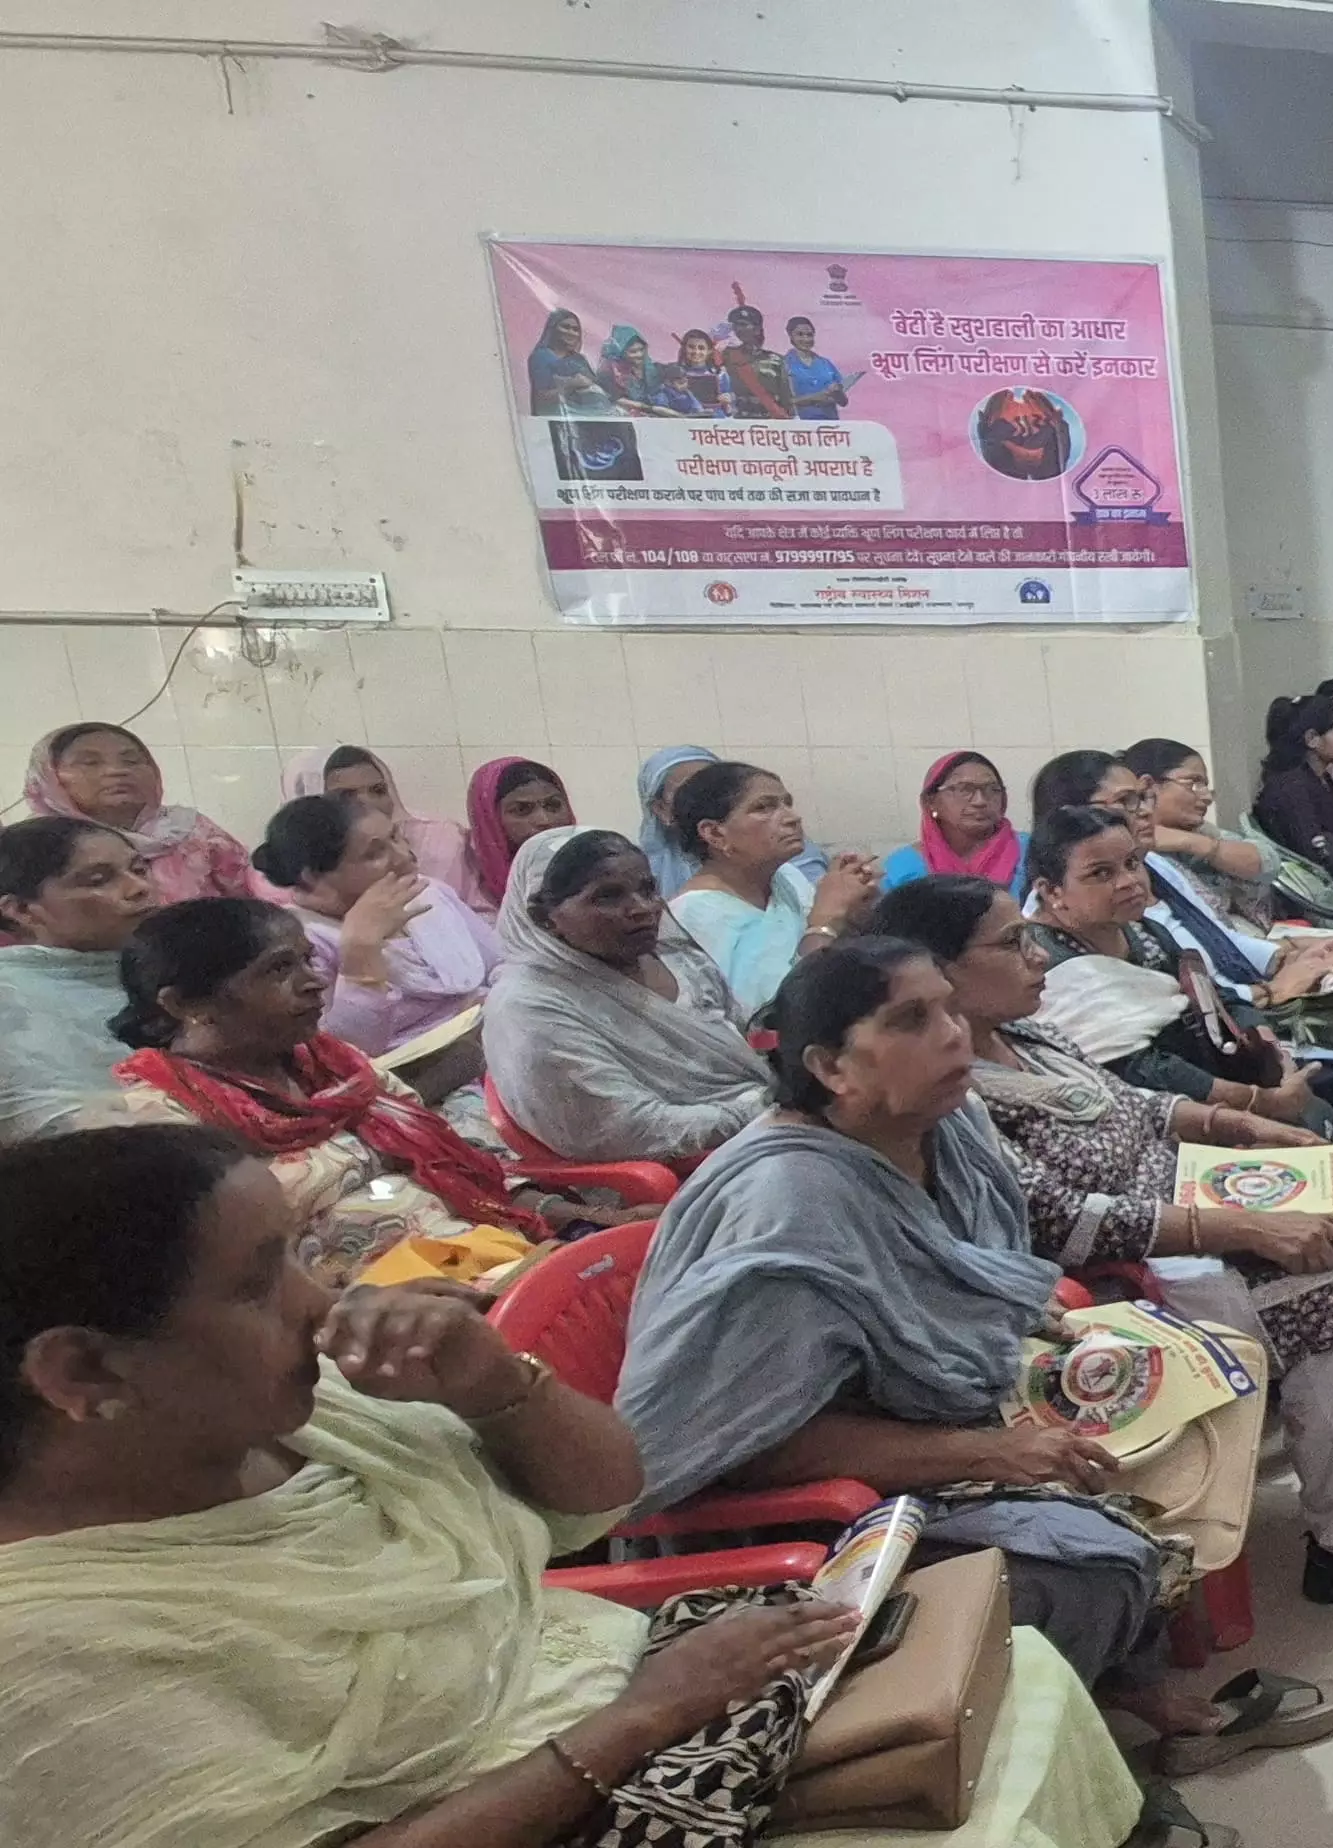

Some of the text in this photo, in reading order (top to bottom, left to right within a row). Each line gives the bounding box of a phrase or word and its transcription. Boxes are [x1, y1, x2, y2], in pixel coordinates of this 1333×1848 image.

[892, 310, 1126, 343] बेटी है खुशहाली का आधार
[872, 347, 1157, 379] भ्रूण लिंग परीक्षण से करें इनकार
[689, 424, 851, 451] गर्भस्थ शिशु का लिंग
[676, 455, 875, 483] परीक्षण कानूनी अपराध है
[607, 486, 650, 502] परीक्षण
[652, 487, 684, 502] कराने
[686, 488, 704, 502] पर
[729, 487, 745, 502] वर्ष
[747, 488, 766, 502] तक
[769, 486, 785, 502] की
[814, 488, 828, 502] का
[829, 488, 870, 502] प्रावधान
[872, 487, 881, 502] है
[642, 548, 699, 566] 104/108
[775, 550, 855, 563] 9799997795
